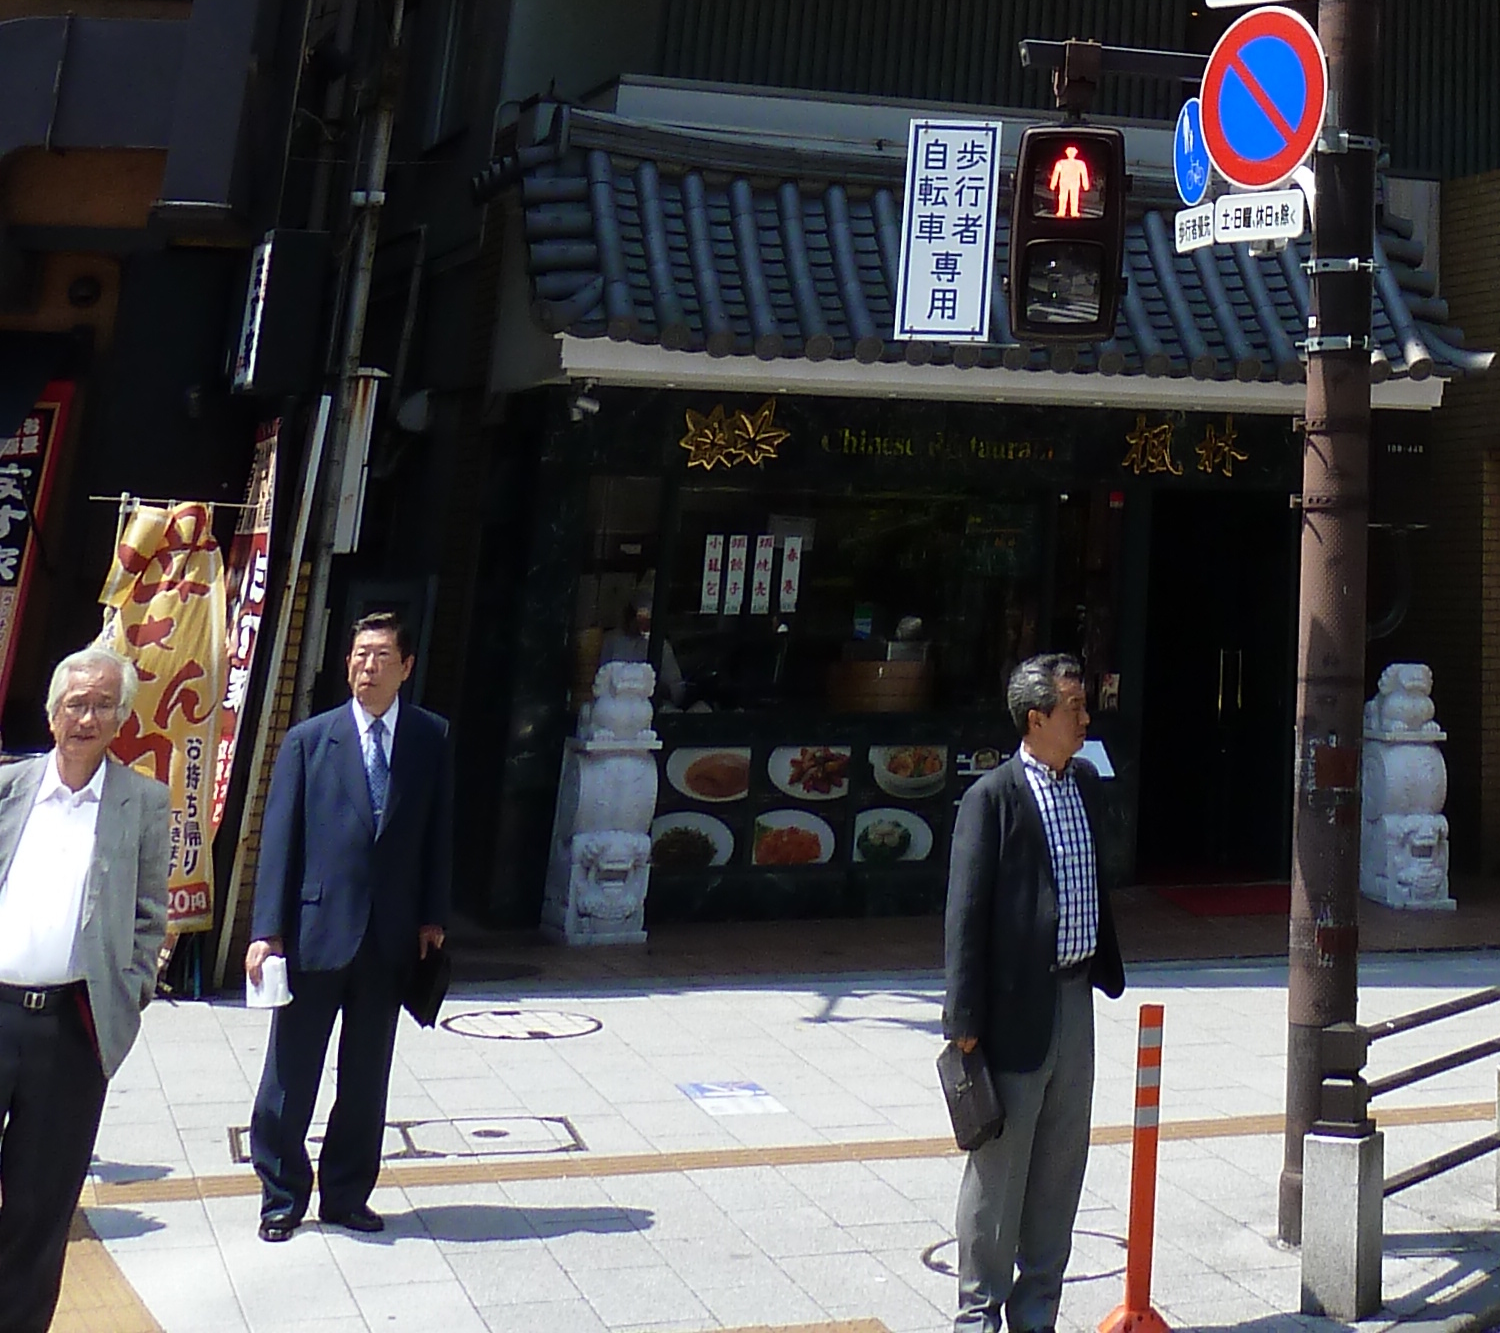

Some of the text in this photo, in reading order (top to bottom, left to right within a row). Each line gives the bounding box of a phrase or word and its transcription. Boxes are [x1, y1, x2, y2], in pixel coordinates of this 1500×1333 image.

[915, 139, 950, 245] 自転車
[951, 139, 988, 245] 歩行者
[926, 250, 963, 321] 専用
[1122, 414, 1249, 477] 楓林
[184, 737, 203, 875] お持ち帰り
